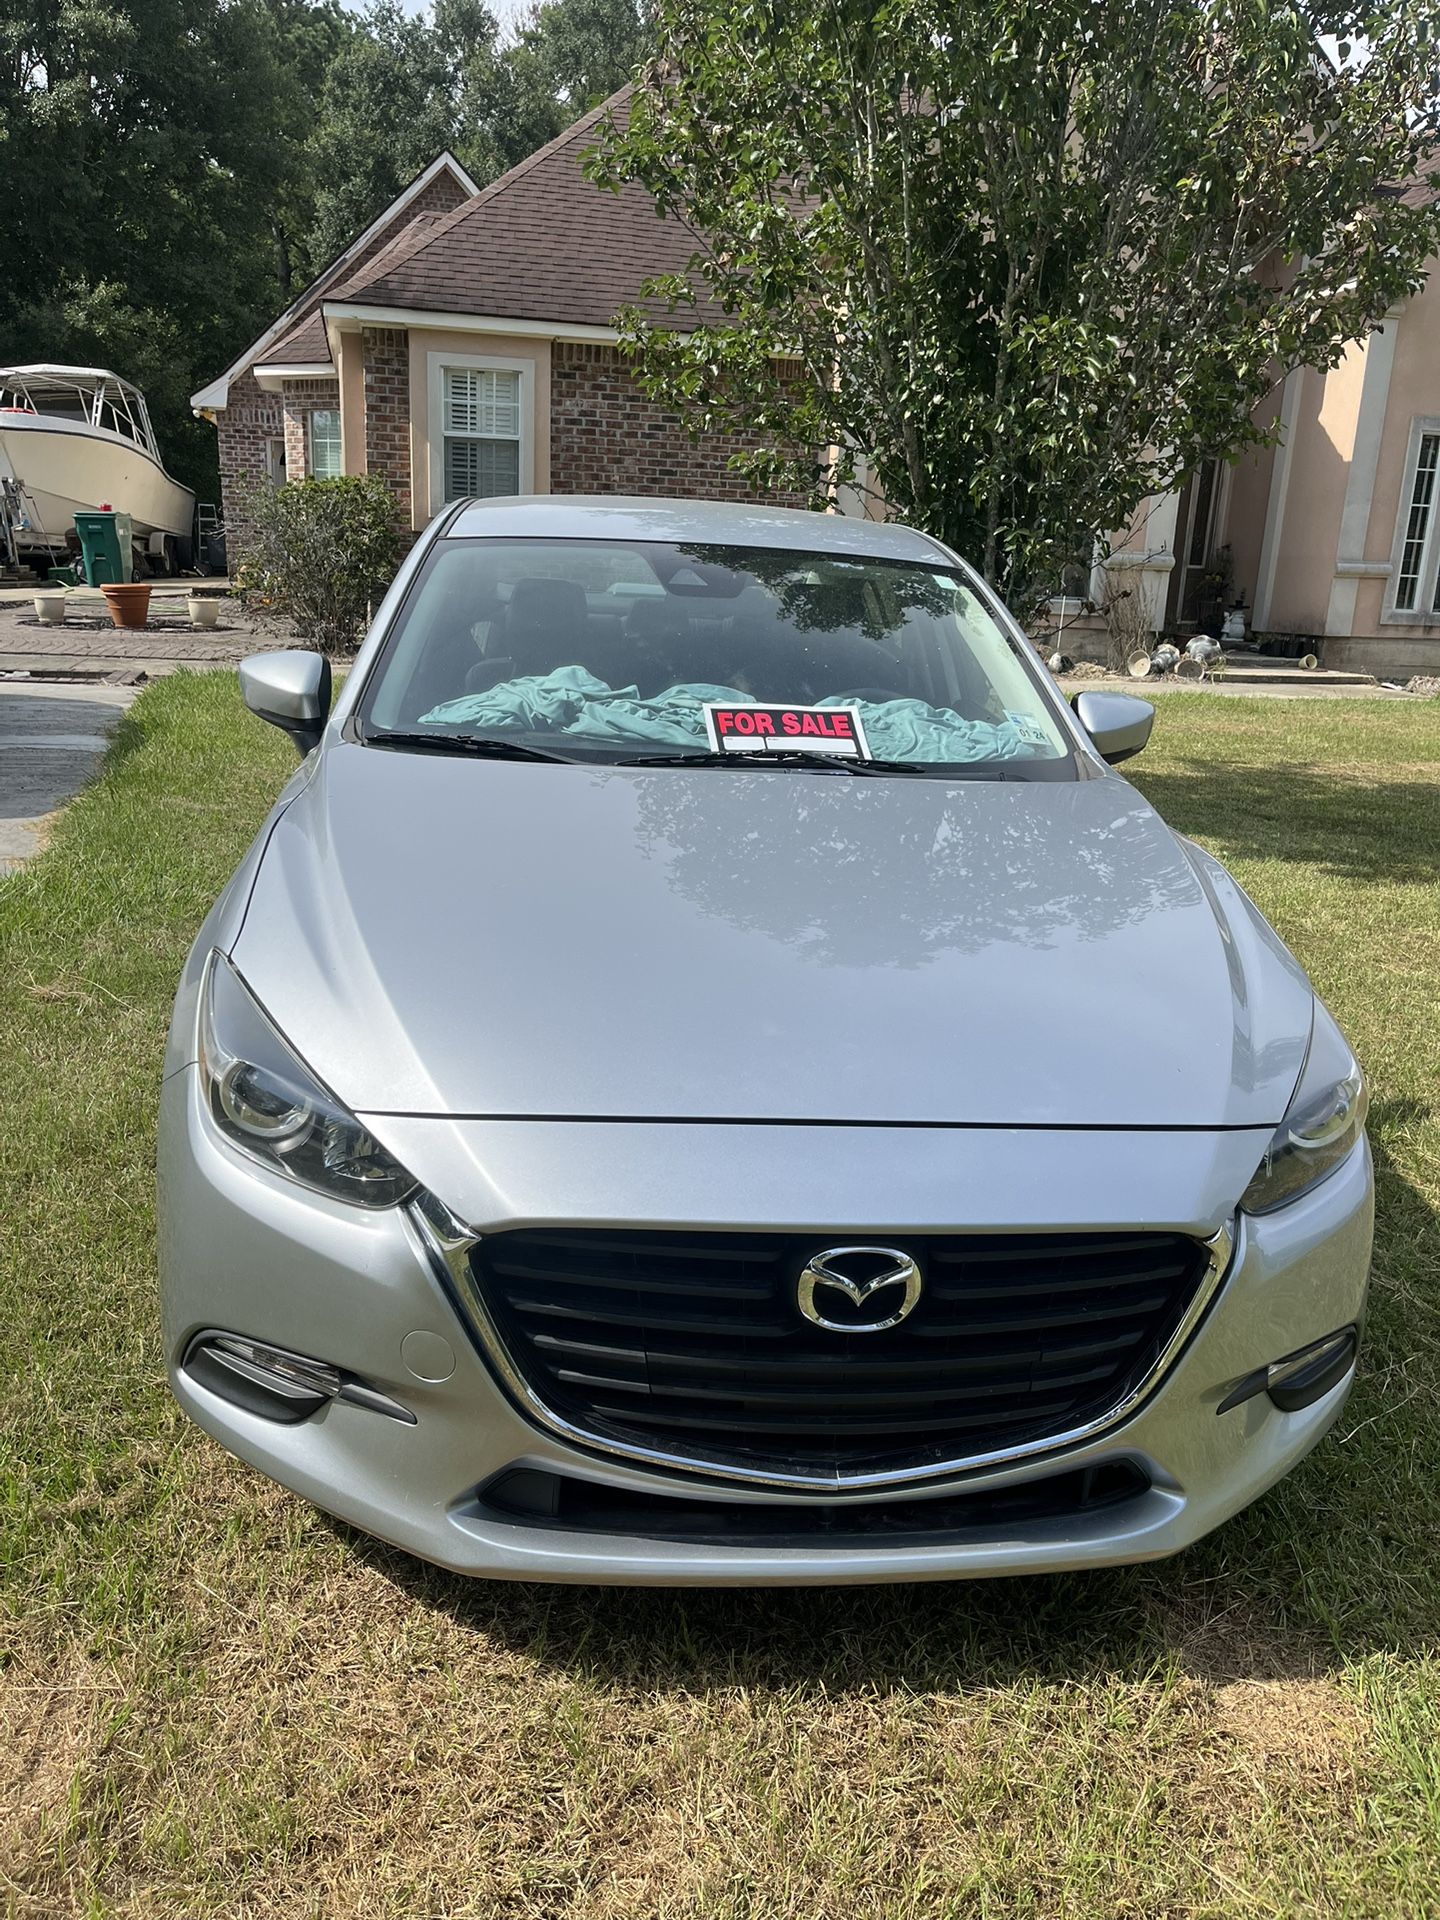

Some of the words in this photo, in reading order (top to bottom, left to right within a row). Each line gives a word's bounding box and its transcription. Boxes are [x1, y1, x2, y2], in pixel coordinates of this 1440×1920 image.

[716, 711, 776, 735] FOR
[781, 713, 853, 737] SALE
[1019, 728, 1032, 738] 01
